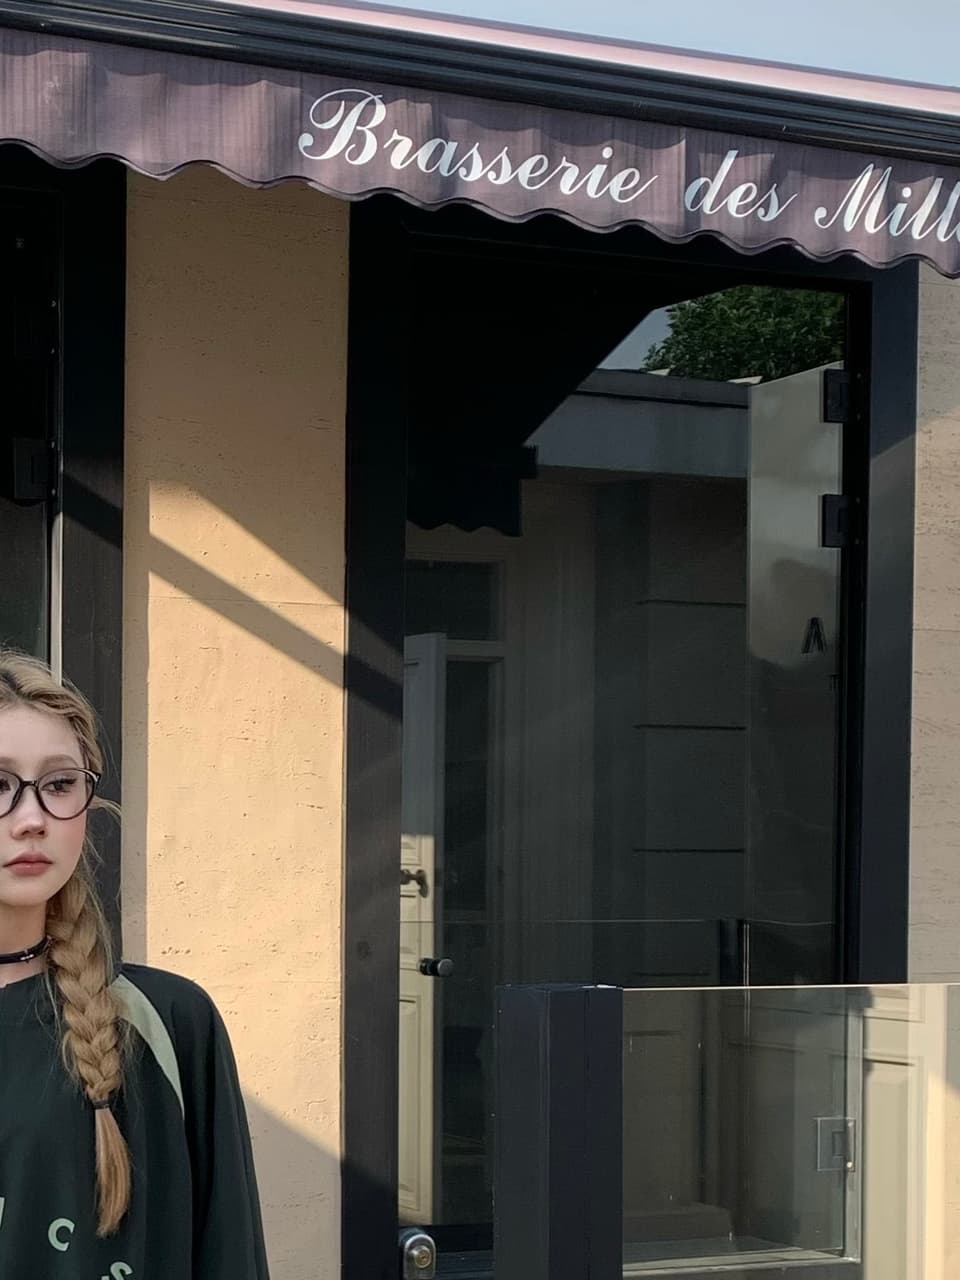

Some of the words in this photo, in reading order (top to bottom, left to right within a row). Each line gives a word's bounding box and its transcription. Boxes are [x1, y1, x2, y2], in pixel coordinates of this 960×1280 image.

[298, 87, 660, 204] Brasserie
[684, 149, 799, 222] des
[814, 163, 960, 243] Mill
